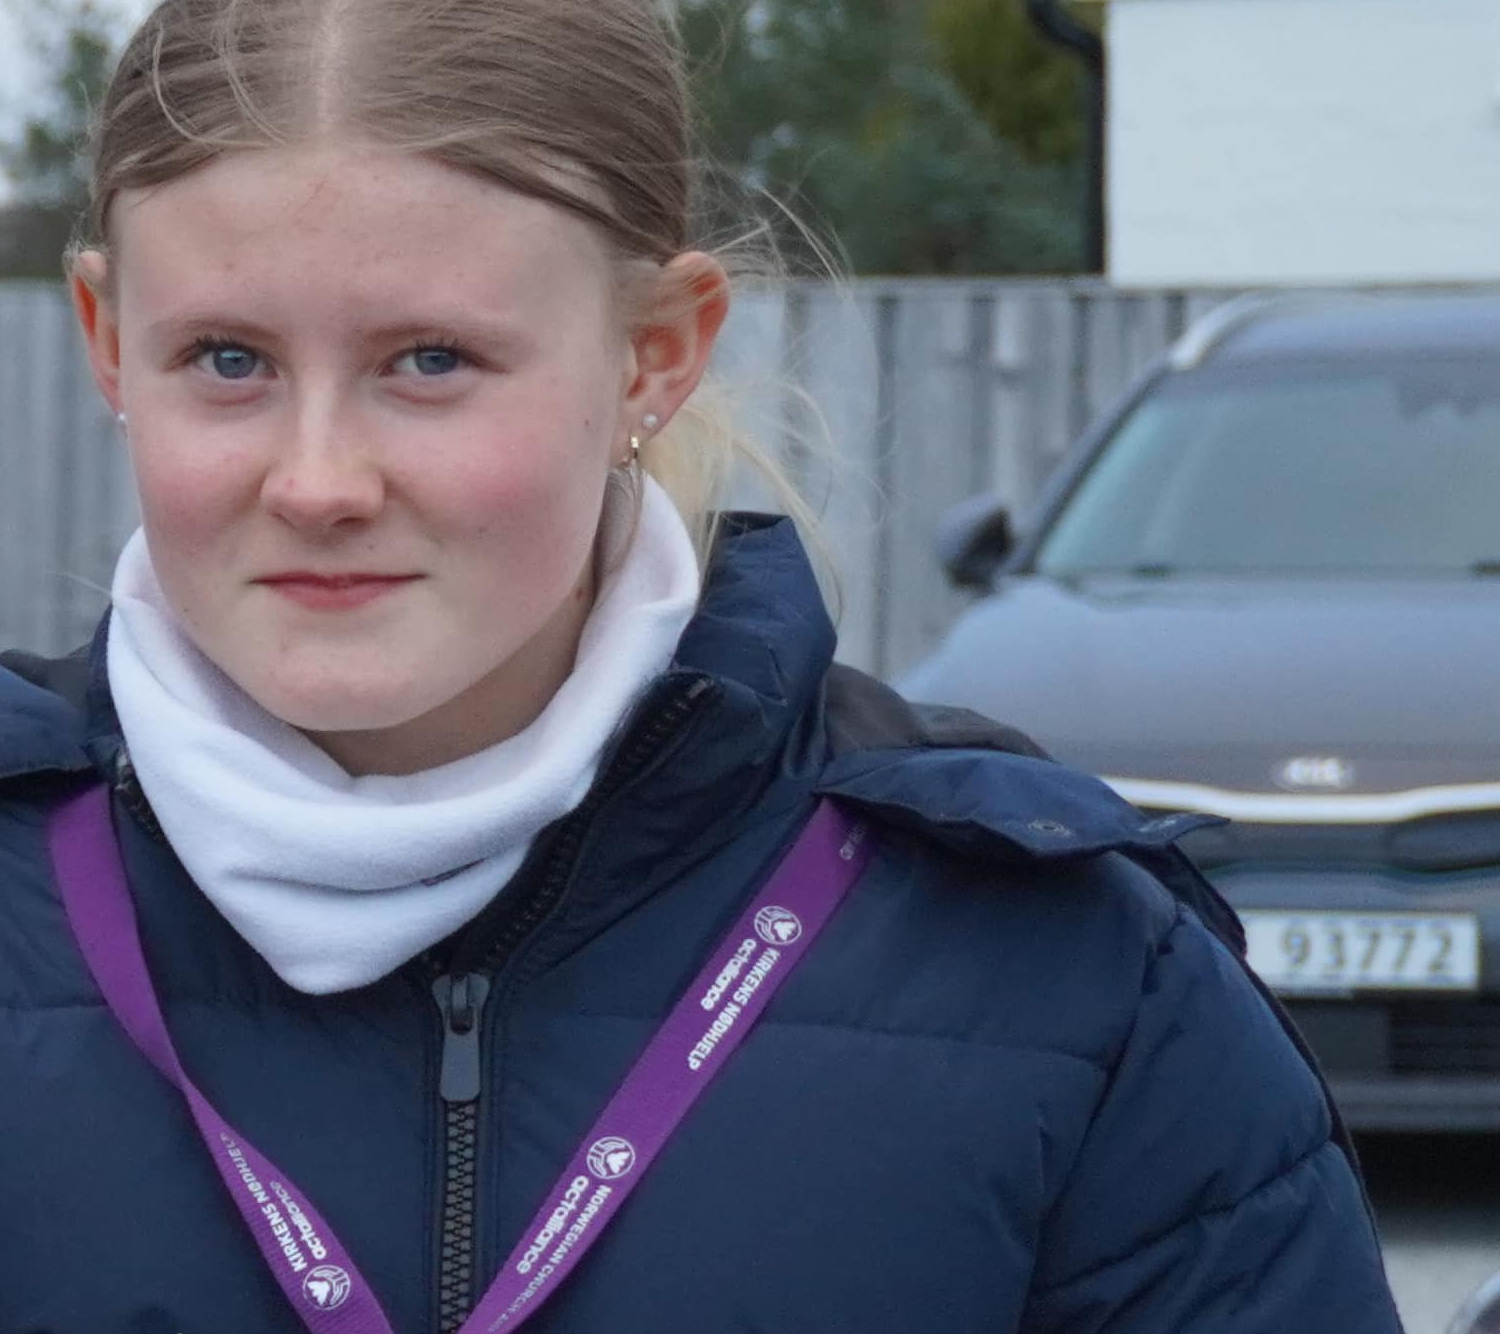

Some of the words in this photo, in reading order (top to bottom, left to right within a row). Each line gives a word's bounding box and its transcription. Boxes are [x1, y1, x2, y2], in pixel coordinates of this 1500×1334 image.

[700, 938, 757, 1011] actalliance
[733, 947, 781, 1006] KIRKENS
[1281, 922, 1453, 971] 93772
[687, 1002, 742, 1071] NØDHJELP
[220, 1132, 269, 1204] NØDHJELP
[261, 1202, 308, 1272] KIRKENS
[269, 1180, 327, 1259] actalliance
[516, 1175, 589, 1274] actalliance
[549, 1184, 612, 1265] NORWEGIAN
[507, 1264, 555, 1313] CHURCH
